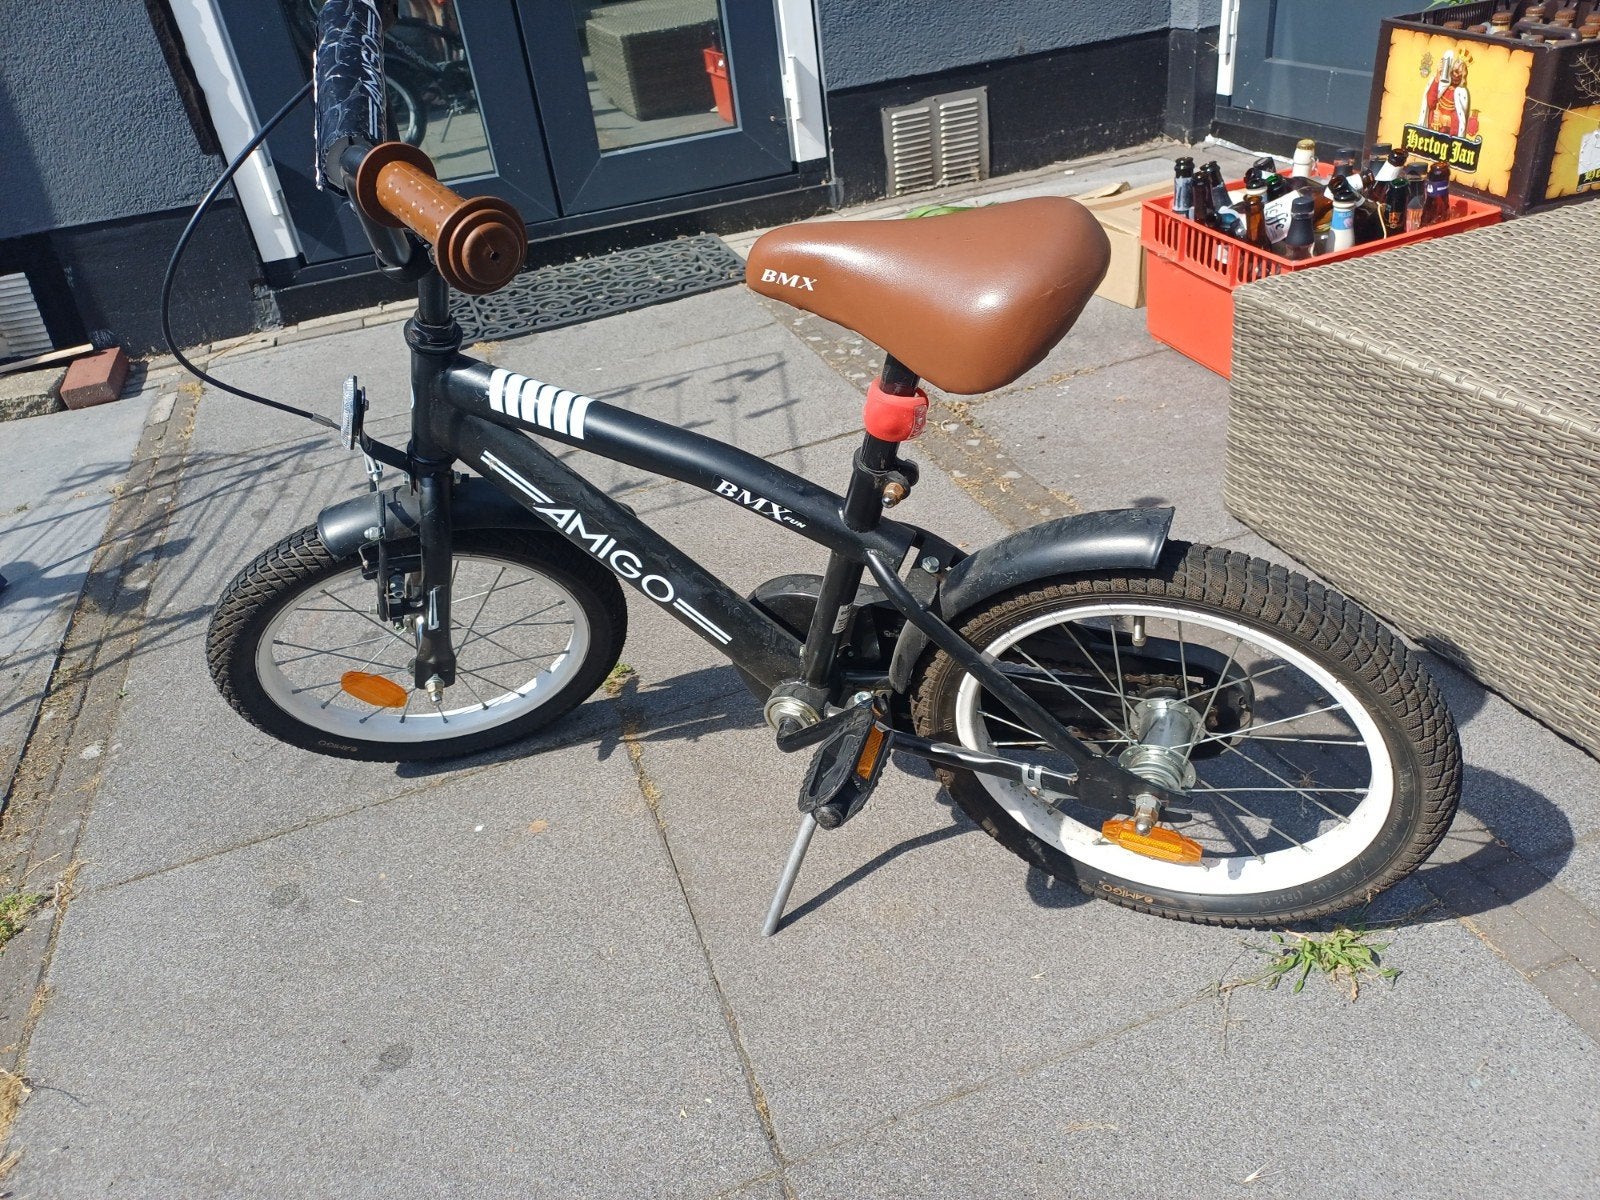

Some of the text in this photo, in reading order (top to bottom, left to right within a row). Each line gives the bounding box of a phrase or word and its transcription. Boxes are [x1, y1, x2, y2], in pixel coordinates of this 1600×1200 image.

[1407, 129, 1475, 166] Hertog Jan
[761, 268, 818, 291] BMX
[713, 478, 806, 529] BMX FUN
[533, 506, 675, 602] AMIGO
[1102, 884, 1146, 900] AMIGO
